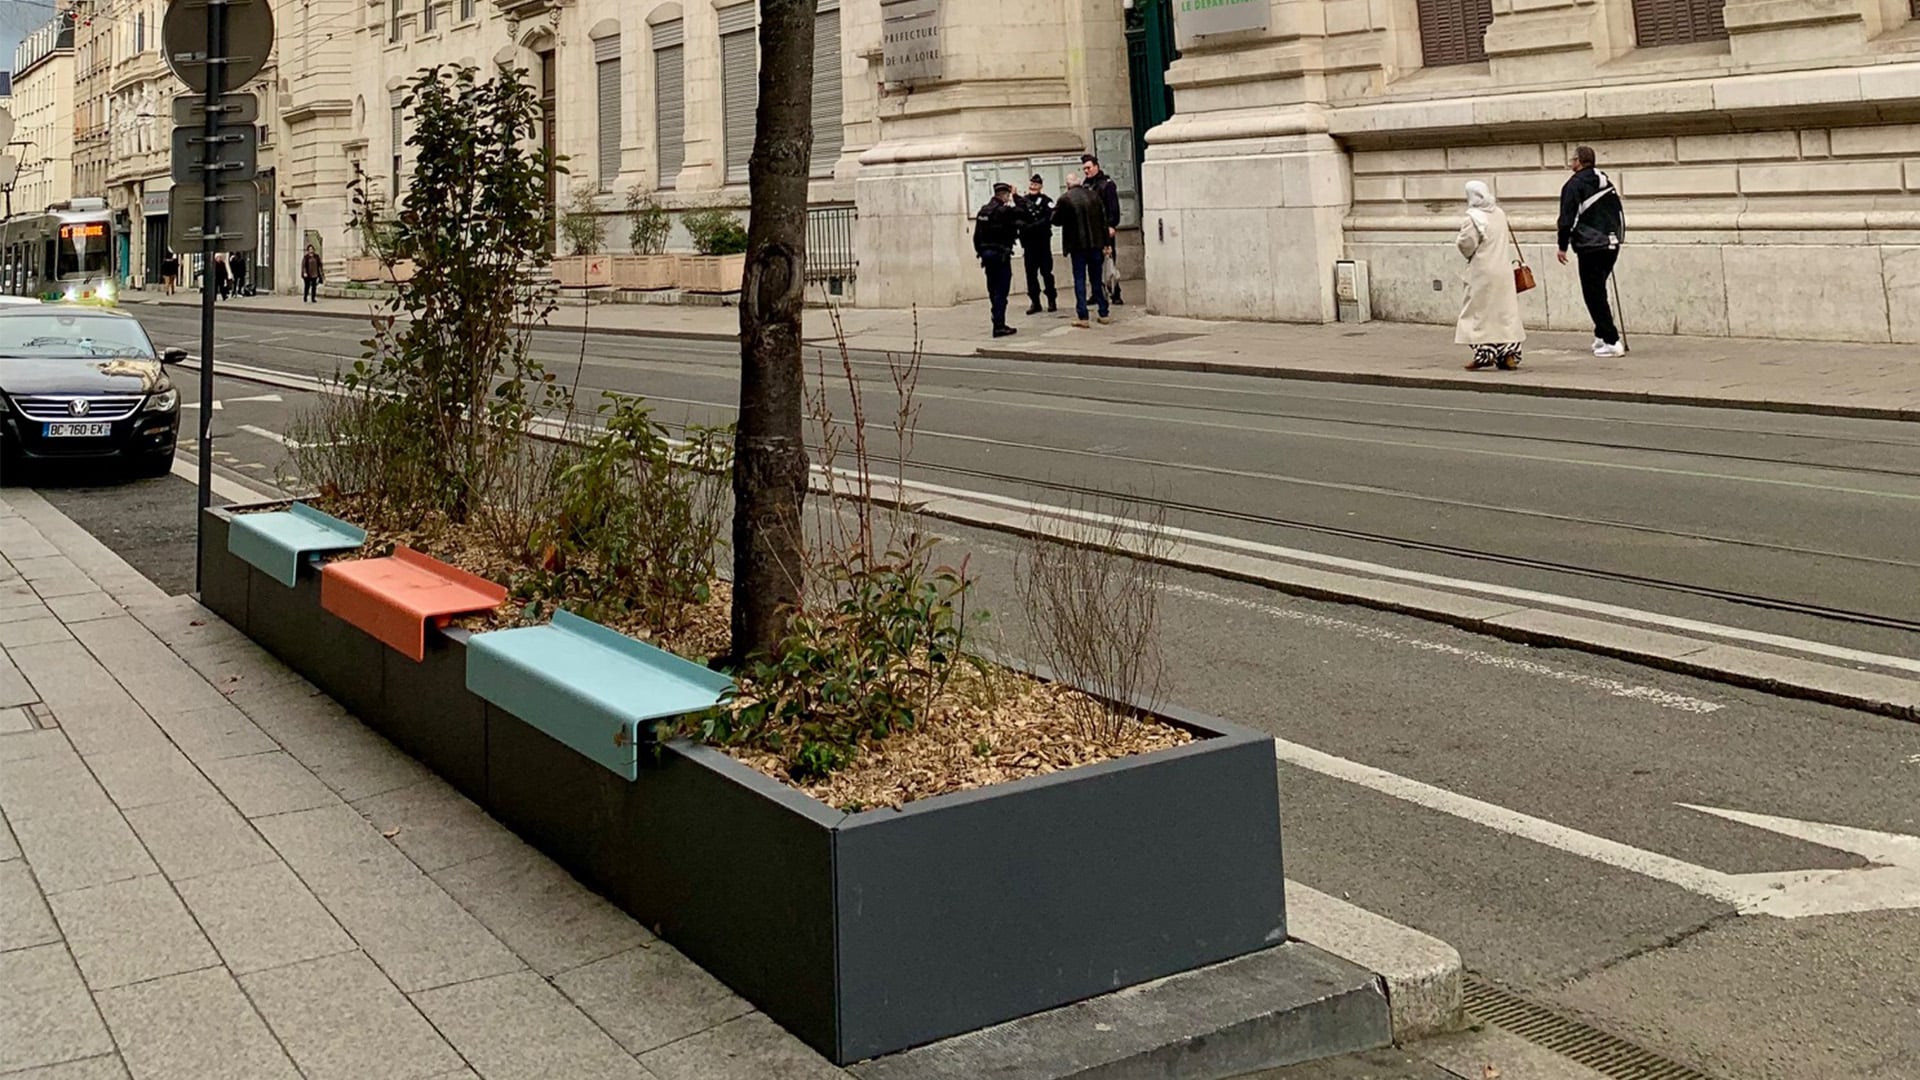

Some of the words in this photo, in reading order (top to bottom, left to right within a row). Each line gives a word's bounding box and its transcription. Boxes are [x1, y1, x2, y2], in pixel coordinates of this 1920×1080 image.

[886, 56, 895, 66] DE
[901, 54, 911, 64] LA
[915, 49, 938, 62] LOIRE
